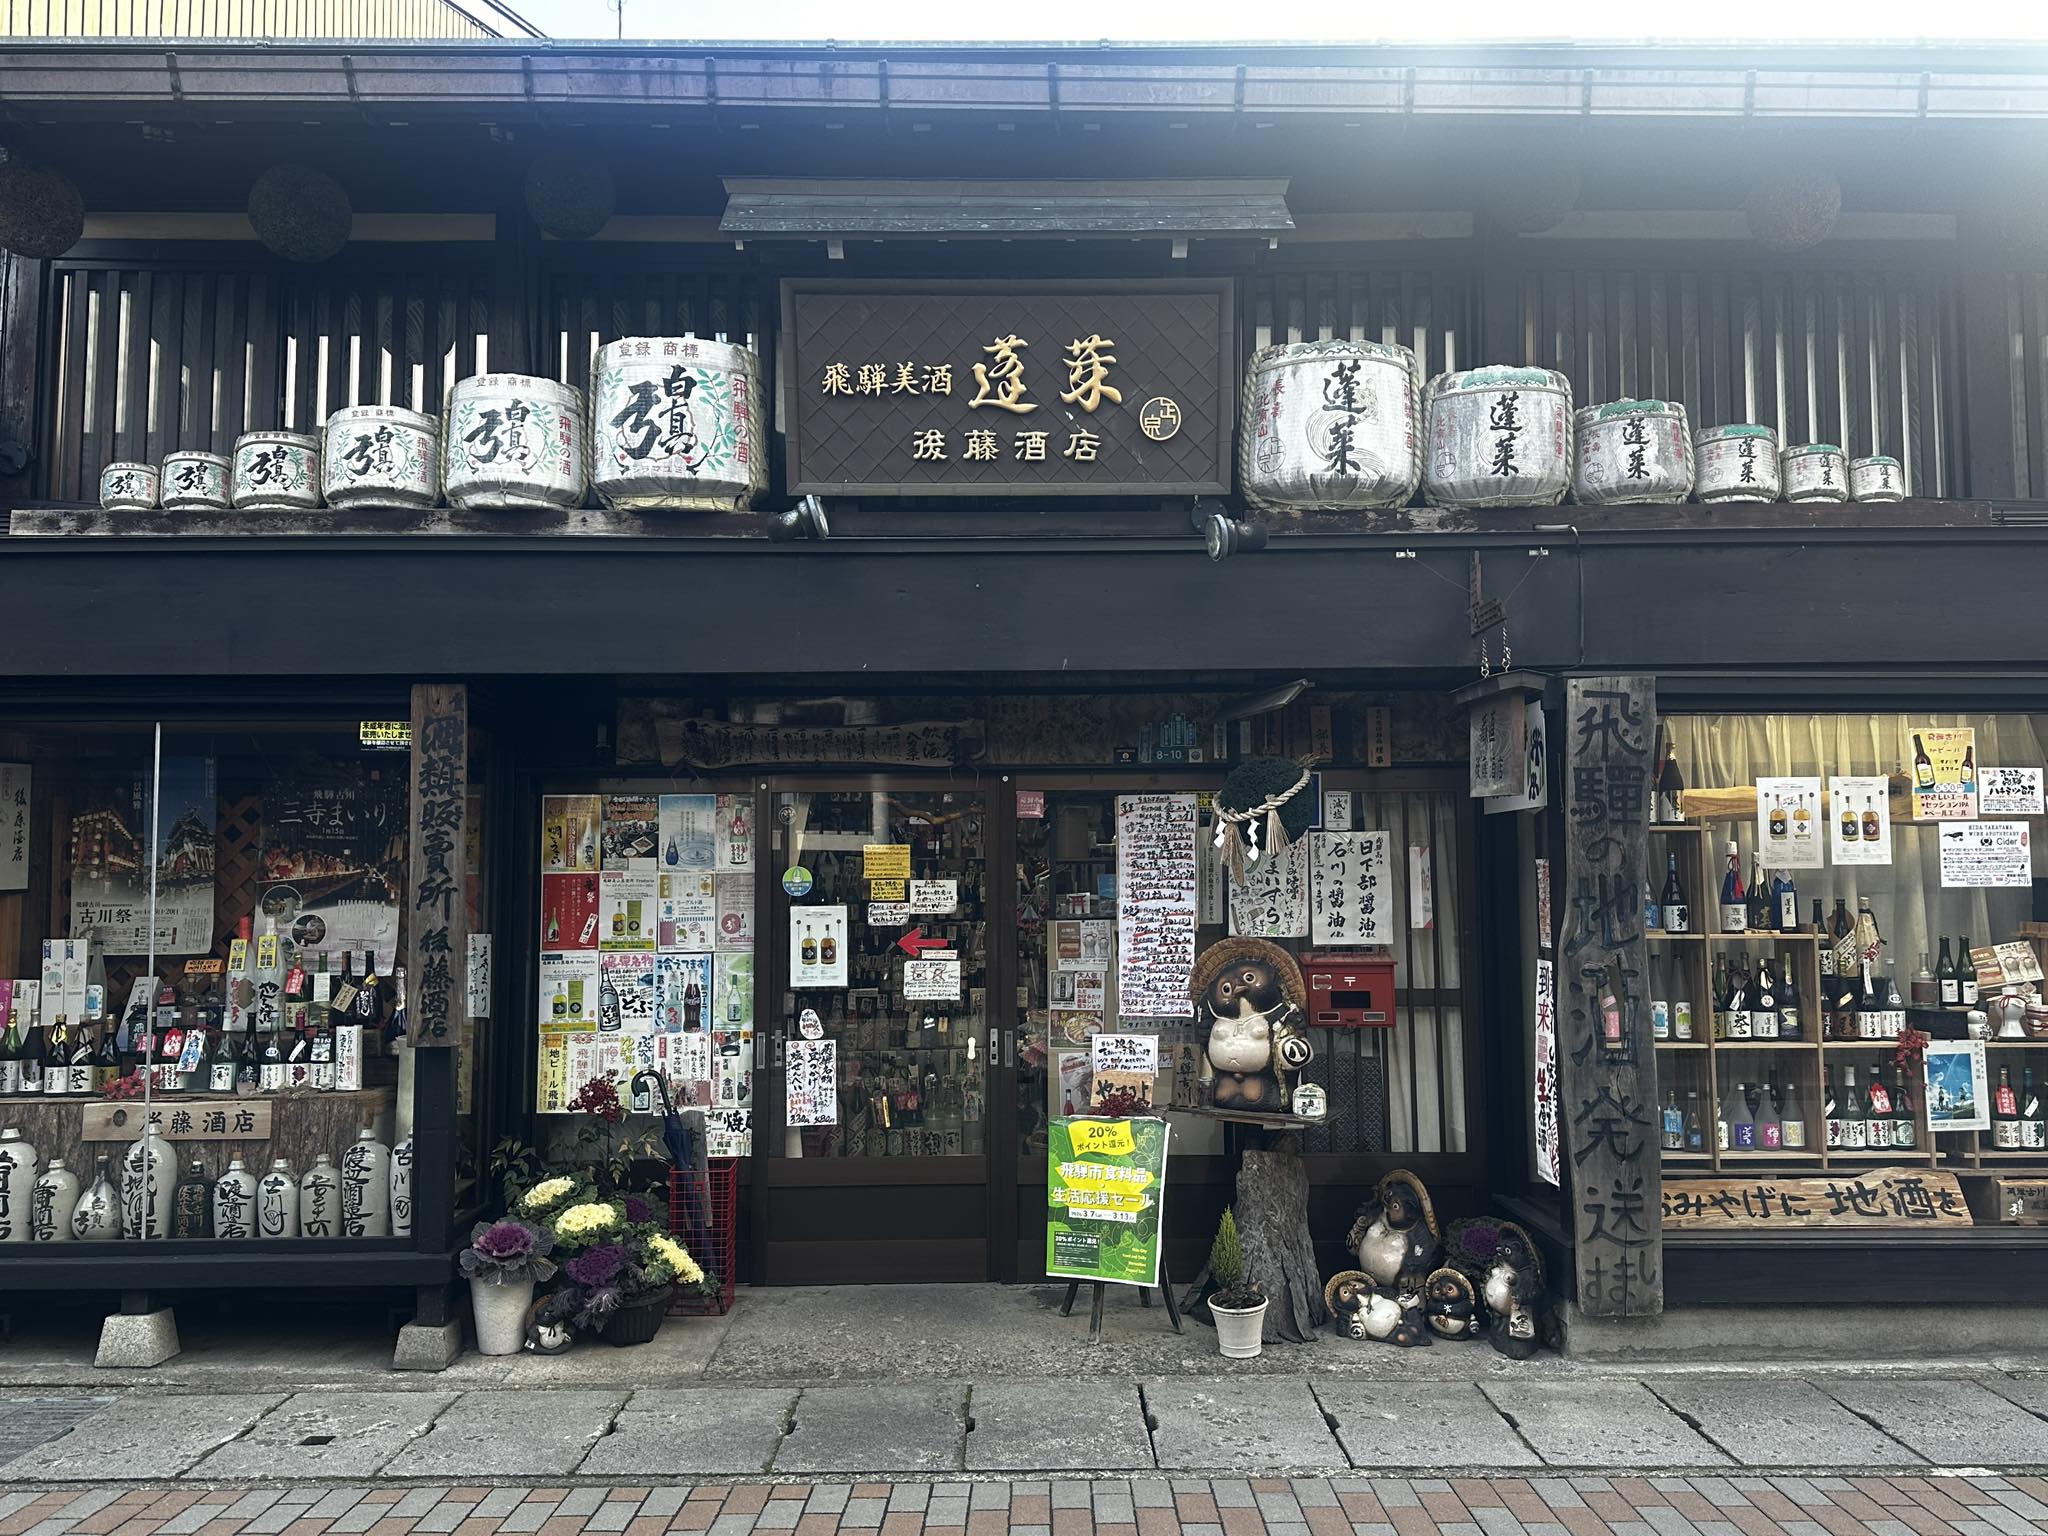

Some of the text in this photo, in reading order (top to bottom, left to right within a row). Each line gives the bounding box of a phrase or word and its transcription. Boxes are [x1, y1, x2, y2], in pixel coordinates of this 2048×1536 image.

[822, 361, 953, 397] 飛騨美酒
[912, 429, 1101, 461] 後藤酒店
[1996, 837, 2018, 846] Cider
[1260, 853, 1284, 925] まいずら
[1327, 841, 1347, 928] 石川の醤油
[79, 908, 132, 924] 古川祭
[1088, 1126, 1117, 1138] 20%
[1060, 1161, 1149, 1184] 飛騨市食料品
[1052, 1186, 1156, 1207] 生活応援セール
